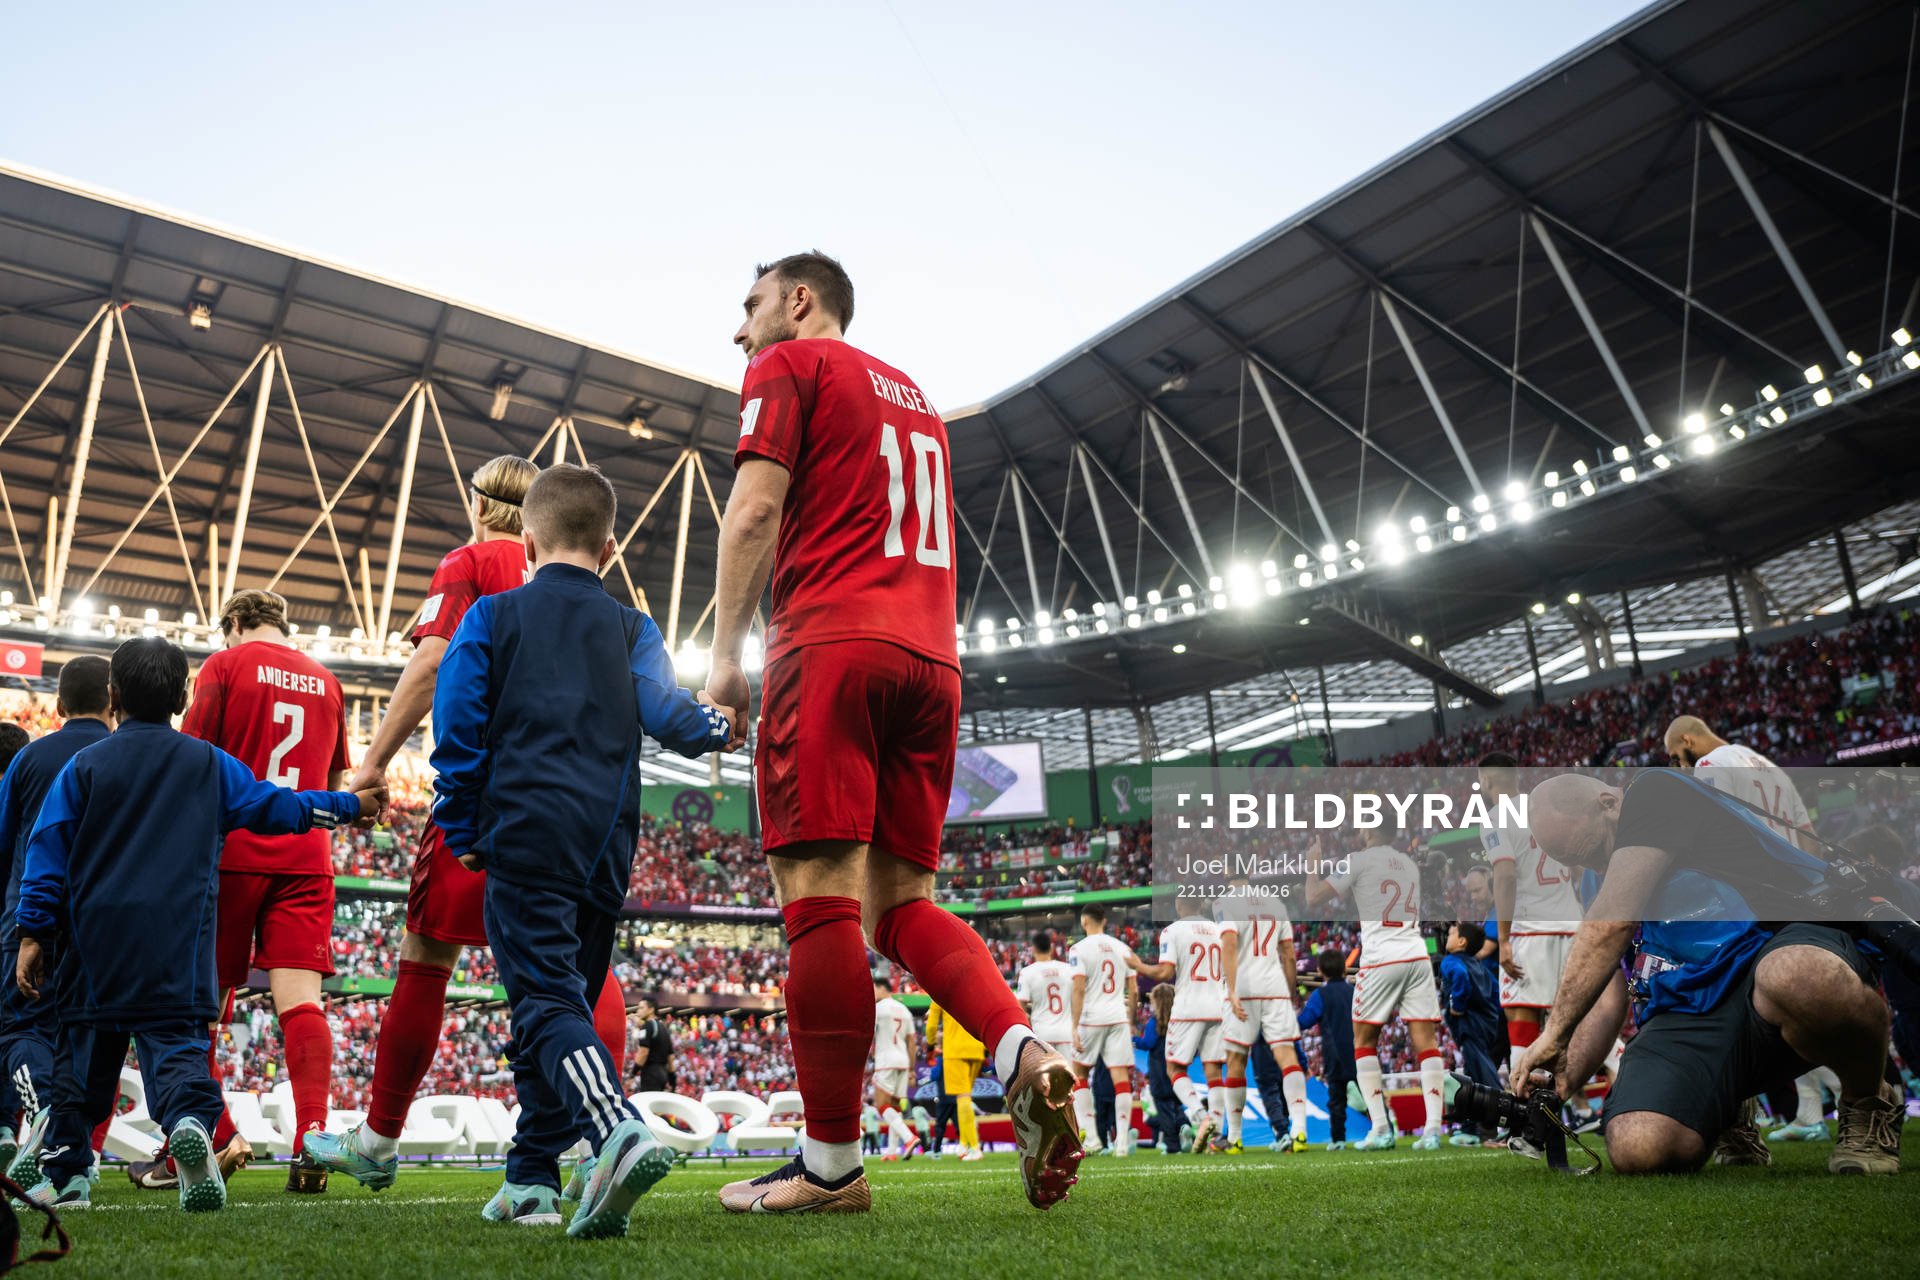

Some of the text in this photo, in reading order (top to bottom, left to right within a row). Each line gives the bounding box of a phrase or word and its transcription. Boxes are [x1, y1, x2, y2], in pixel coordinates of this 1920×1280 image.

[867, 367, 937, 418] ERIKSEN
[880, 422, 950, 570] 10
[257, 665, 325, 696] ANDERSEN
[266, 701, 305, 790] 2
[1381, 879, 1417, 928] 24
[1248, 914, 1276, 957] 17
[1102, 959, 1115, 994] 3
[1190, 942, 1222, 982] 20
[1047, 983, 1063, 1015] 6
[893, 1017, 903, 1045] 7
